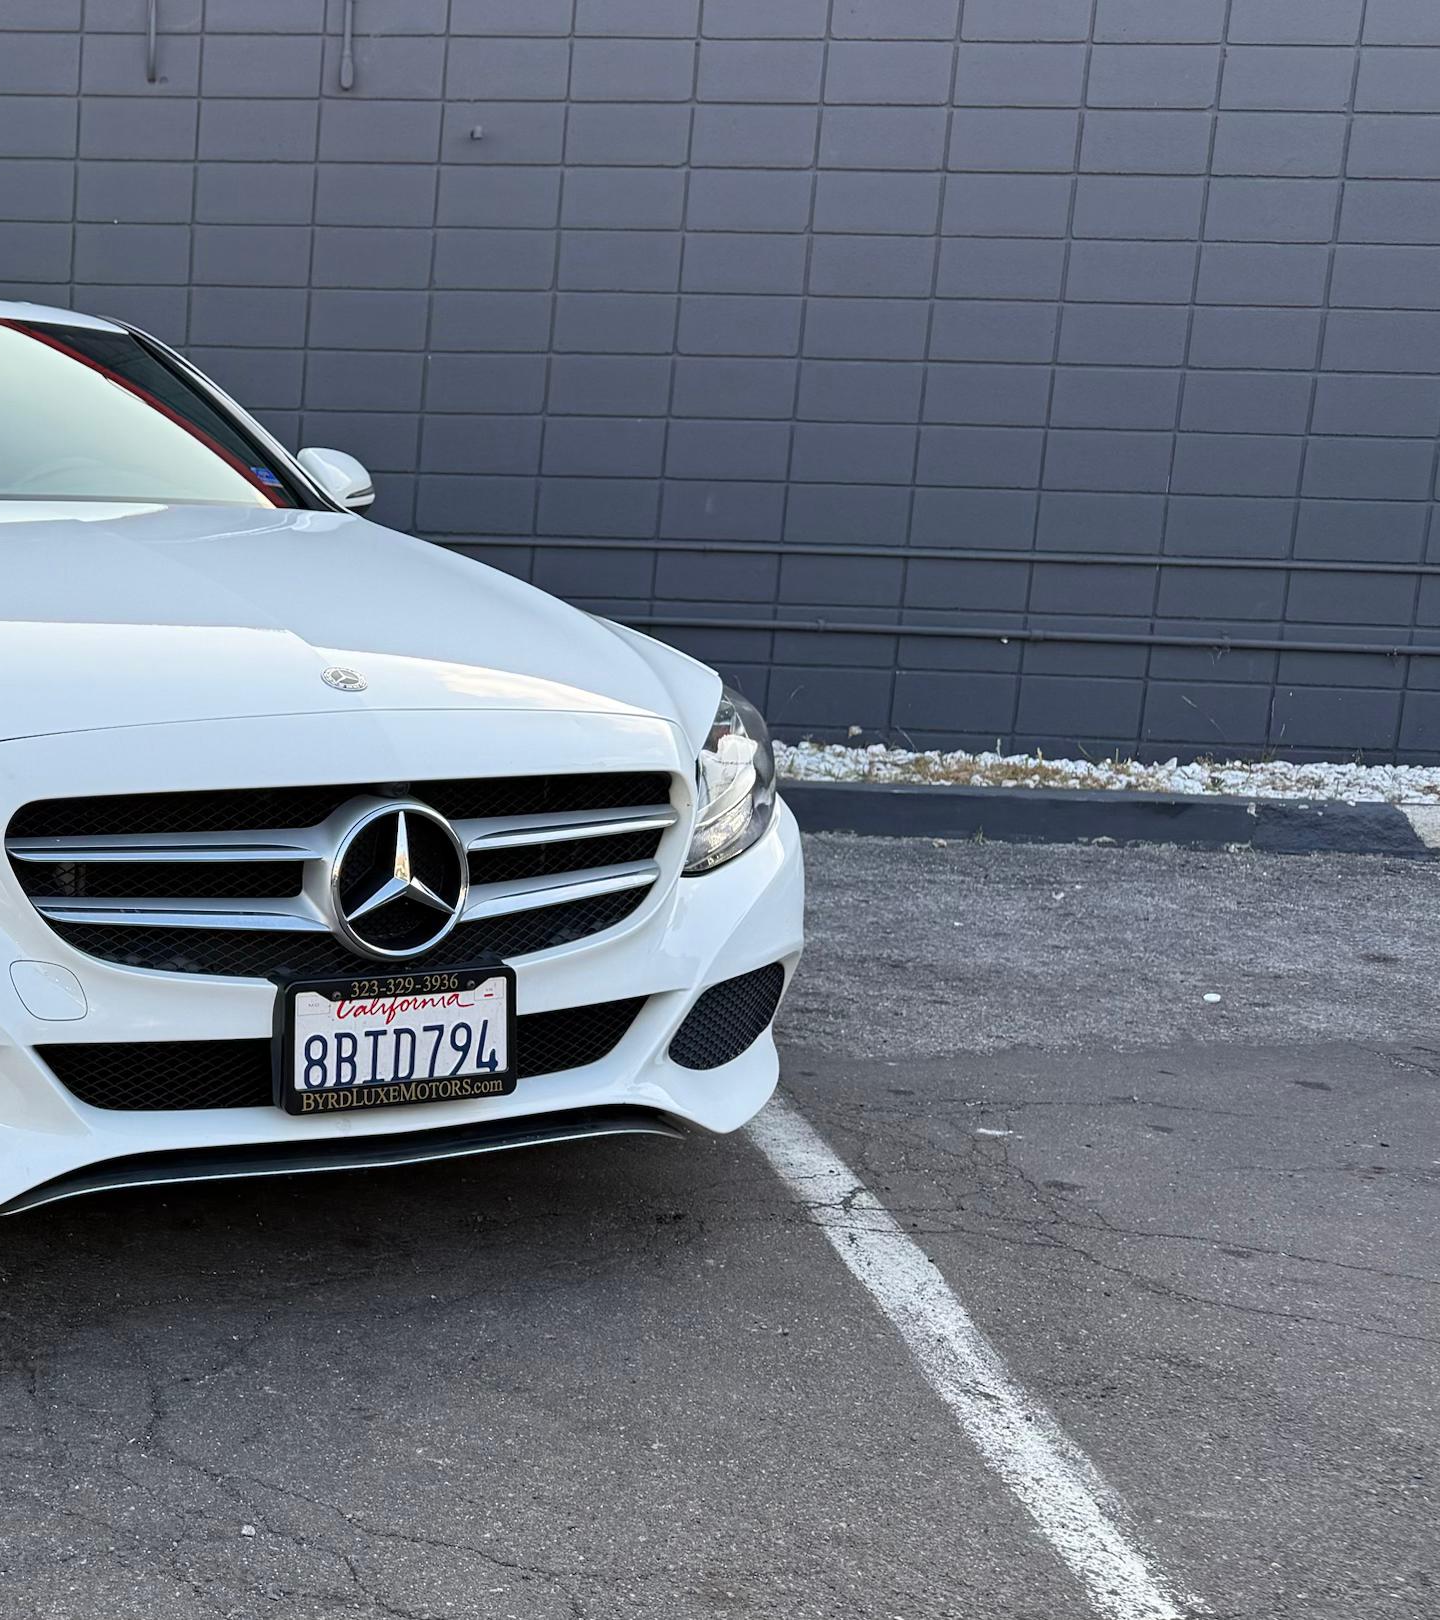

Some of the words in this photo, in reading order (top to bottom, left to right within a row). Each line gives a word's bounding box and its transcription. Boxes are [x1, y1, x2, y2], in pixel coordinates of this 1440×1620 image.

[350, 973, 459, 998] 323-329-3936
[336, 993, 475, 1025] California
[303, 1019, 499, 1089] 8BID794
